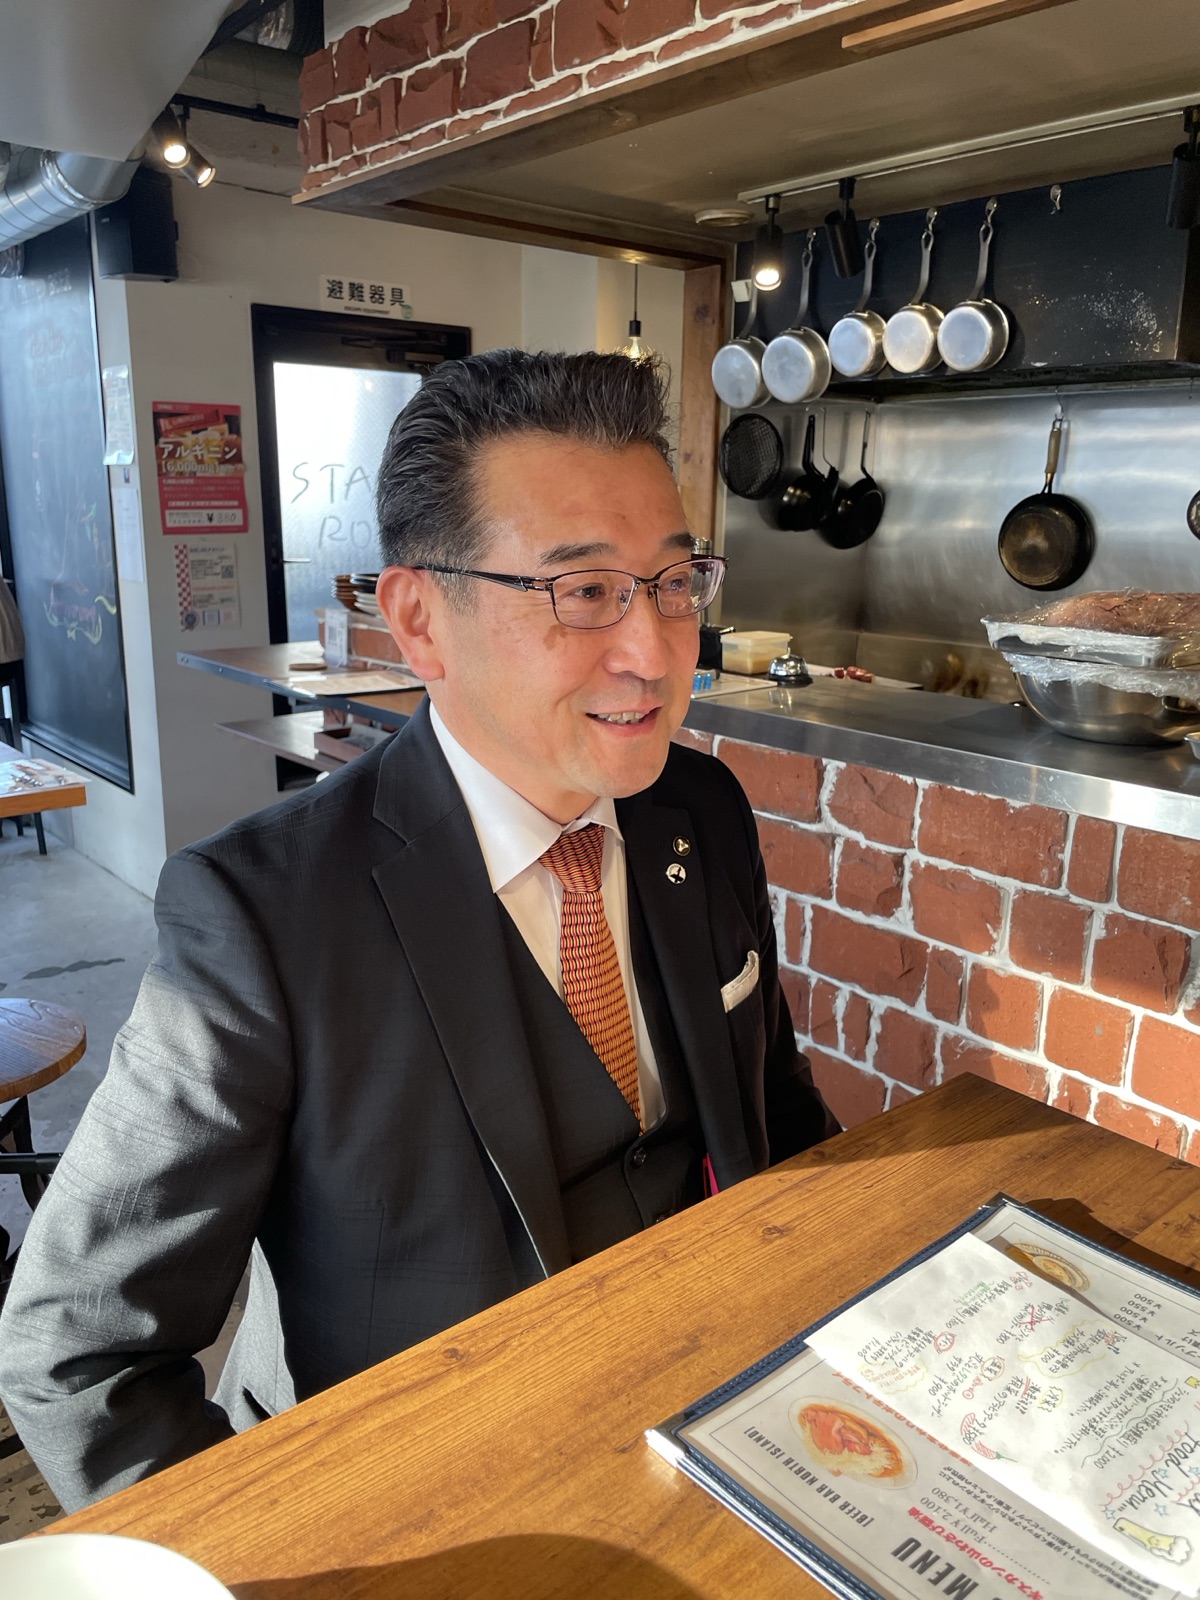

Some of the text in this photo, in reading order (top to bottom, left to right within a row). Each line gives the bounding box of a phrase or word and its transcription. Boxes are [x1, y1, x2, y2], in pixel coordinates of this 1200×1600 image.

[326, 278, 405, 307] 避難器具
[160, 443, 238, 460] アルギニン
[1153, 1334, 1199, 1359] ブソルト
[782, 1456, 818, 1485] NORTH
[815, 1483, 841, 1503] BAR
[966, 1512, 997, 1532] Half
[960, 1524, 985, 1543] Full
[891, 1537, 978, 1598] MENU
